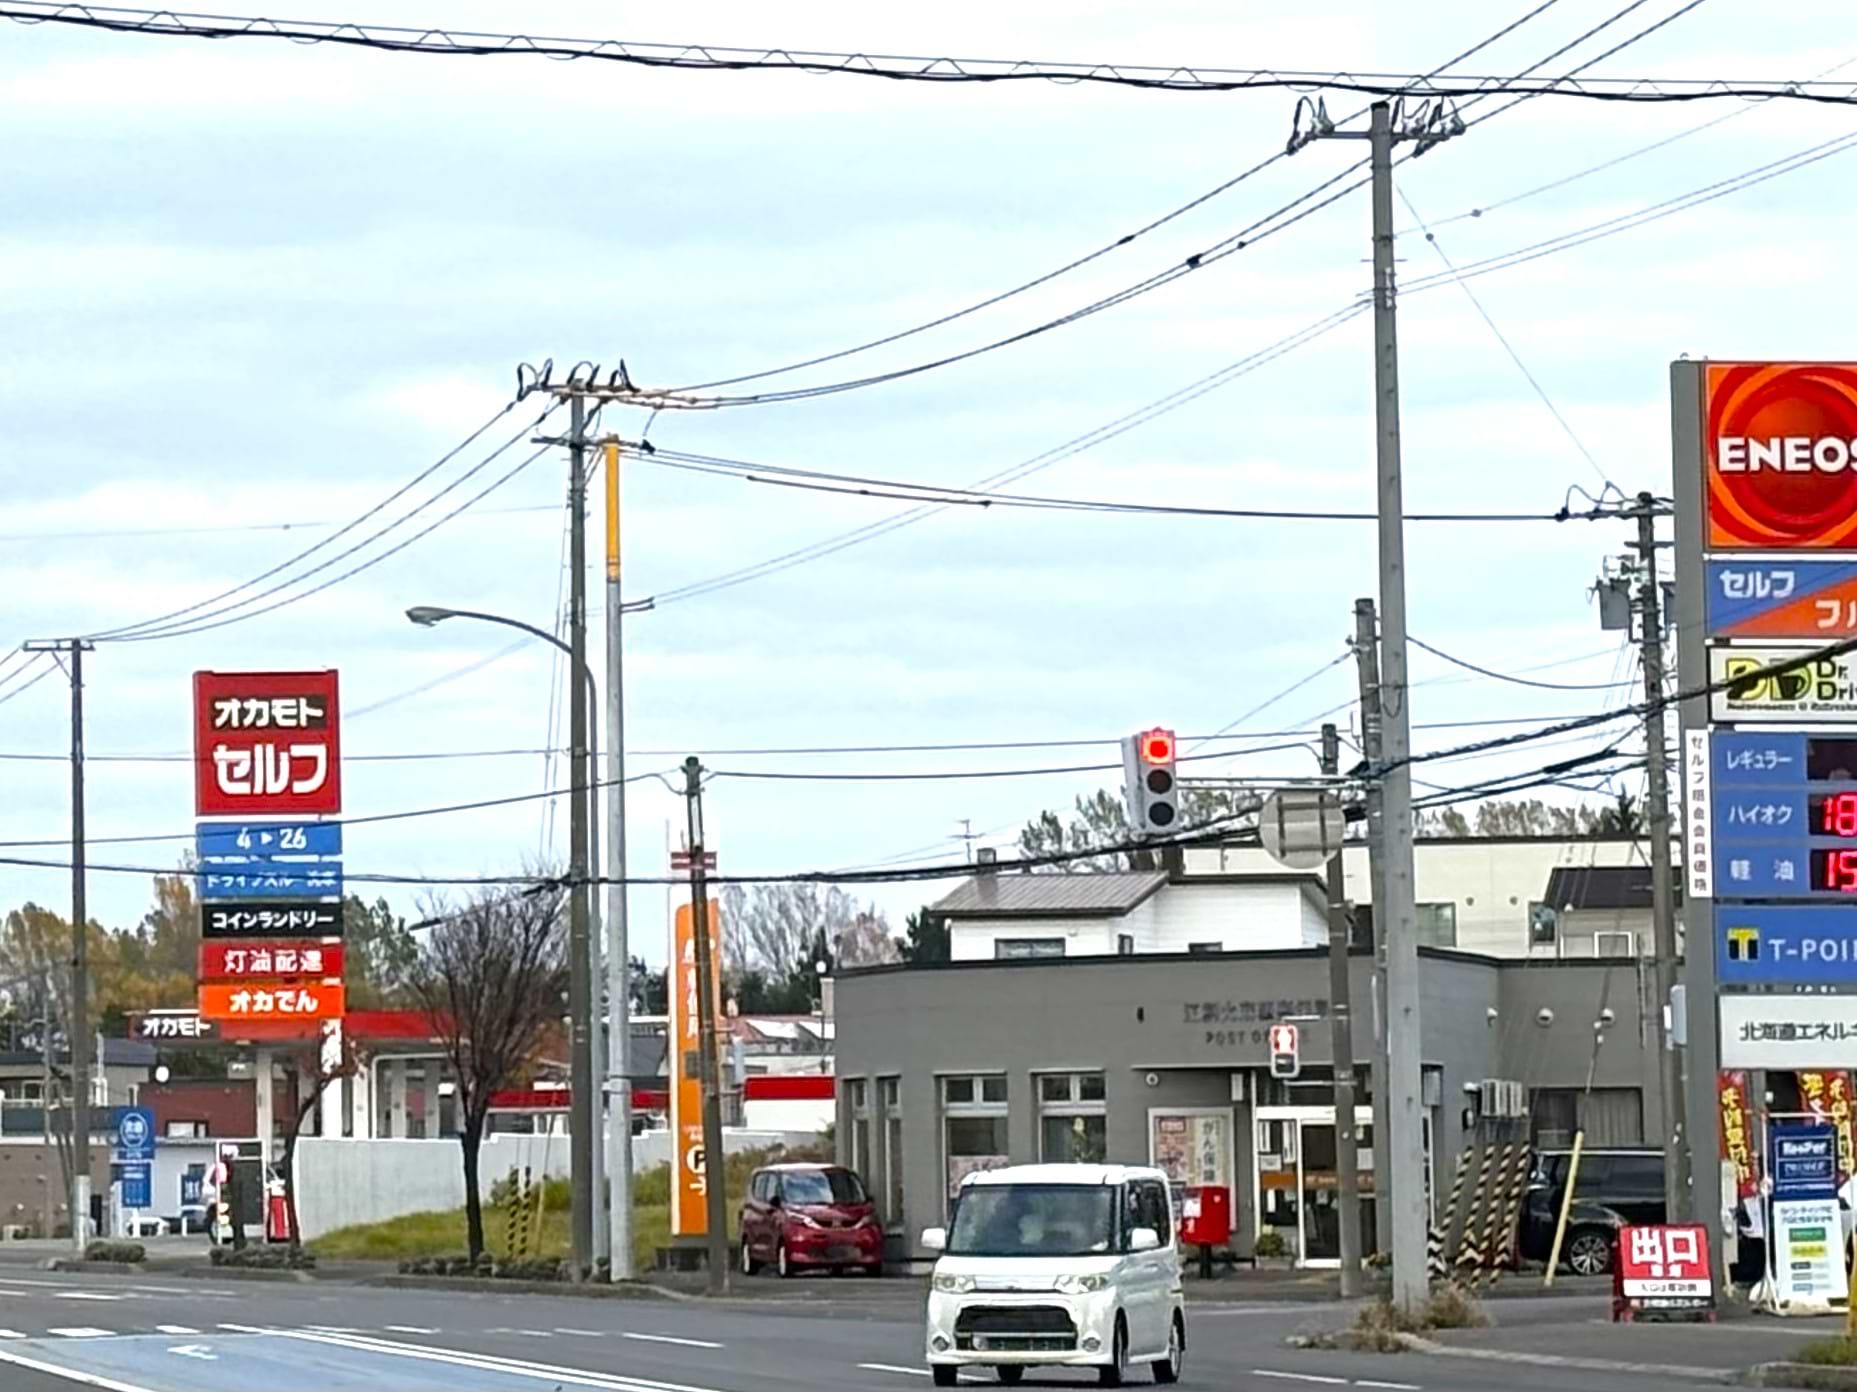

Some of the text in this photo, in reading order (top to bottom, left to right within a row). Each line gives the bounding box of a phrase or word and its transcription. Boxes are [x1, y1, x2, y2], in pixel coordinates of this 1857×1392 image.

[1720, 569, 1795, 598] セルフ
[1816, 681, 1857, 701] Dri
[214, 698, 323, 728] オカモト
[213, 743, 327, 794] セルフ
[1726, 750, 1792, 769] レギュラー
[1728, 805, 1792, 825] ハイオク
[279, 827, 307, 849] 26
[212, 910, 334, 931] コインランドリー
[1768, 938, 1857, 962] T-POI
[229, 990, 319, 1013] オカでん
[142, 1017, 211, 1037] オカモト
[1632, 1227, 1698, 1265] 出口
